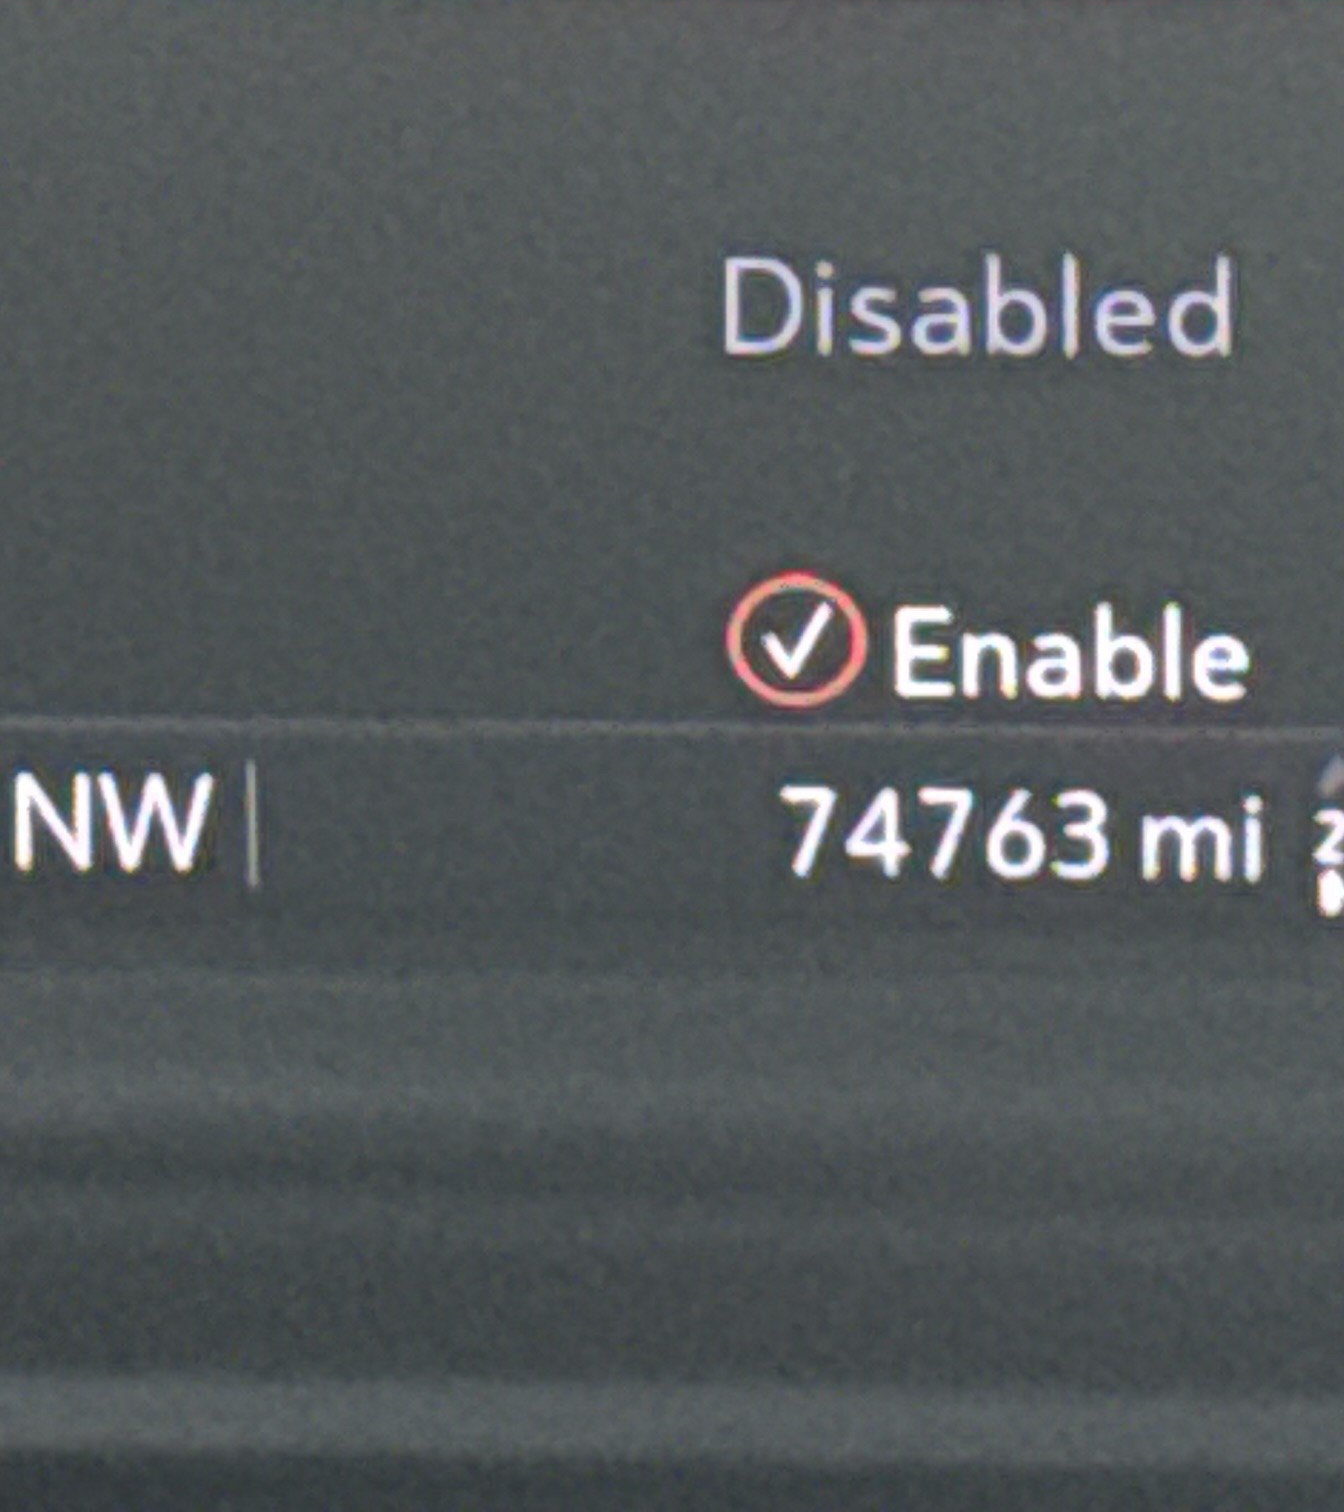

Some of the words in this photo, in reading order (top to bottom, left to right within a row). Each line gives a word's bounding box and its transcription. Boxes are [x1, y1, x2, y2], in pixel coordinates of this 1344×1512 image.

[724, 252, 1232, 359] Disabled
[893, 601, 1251, 703] Enable
[13, 771, 214, 873] NW
[778, 784, 1111, 881] 74763
[1141, 794, 1264, 884] mi
